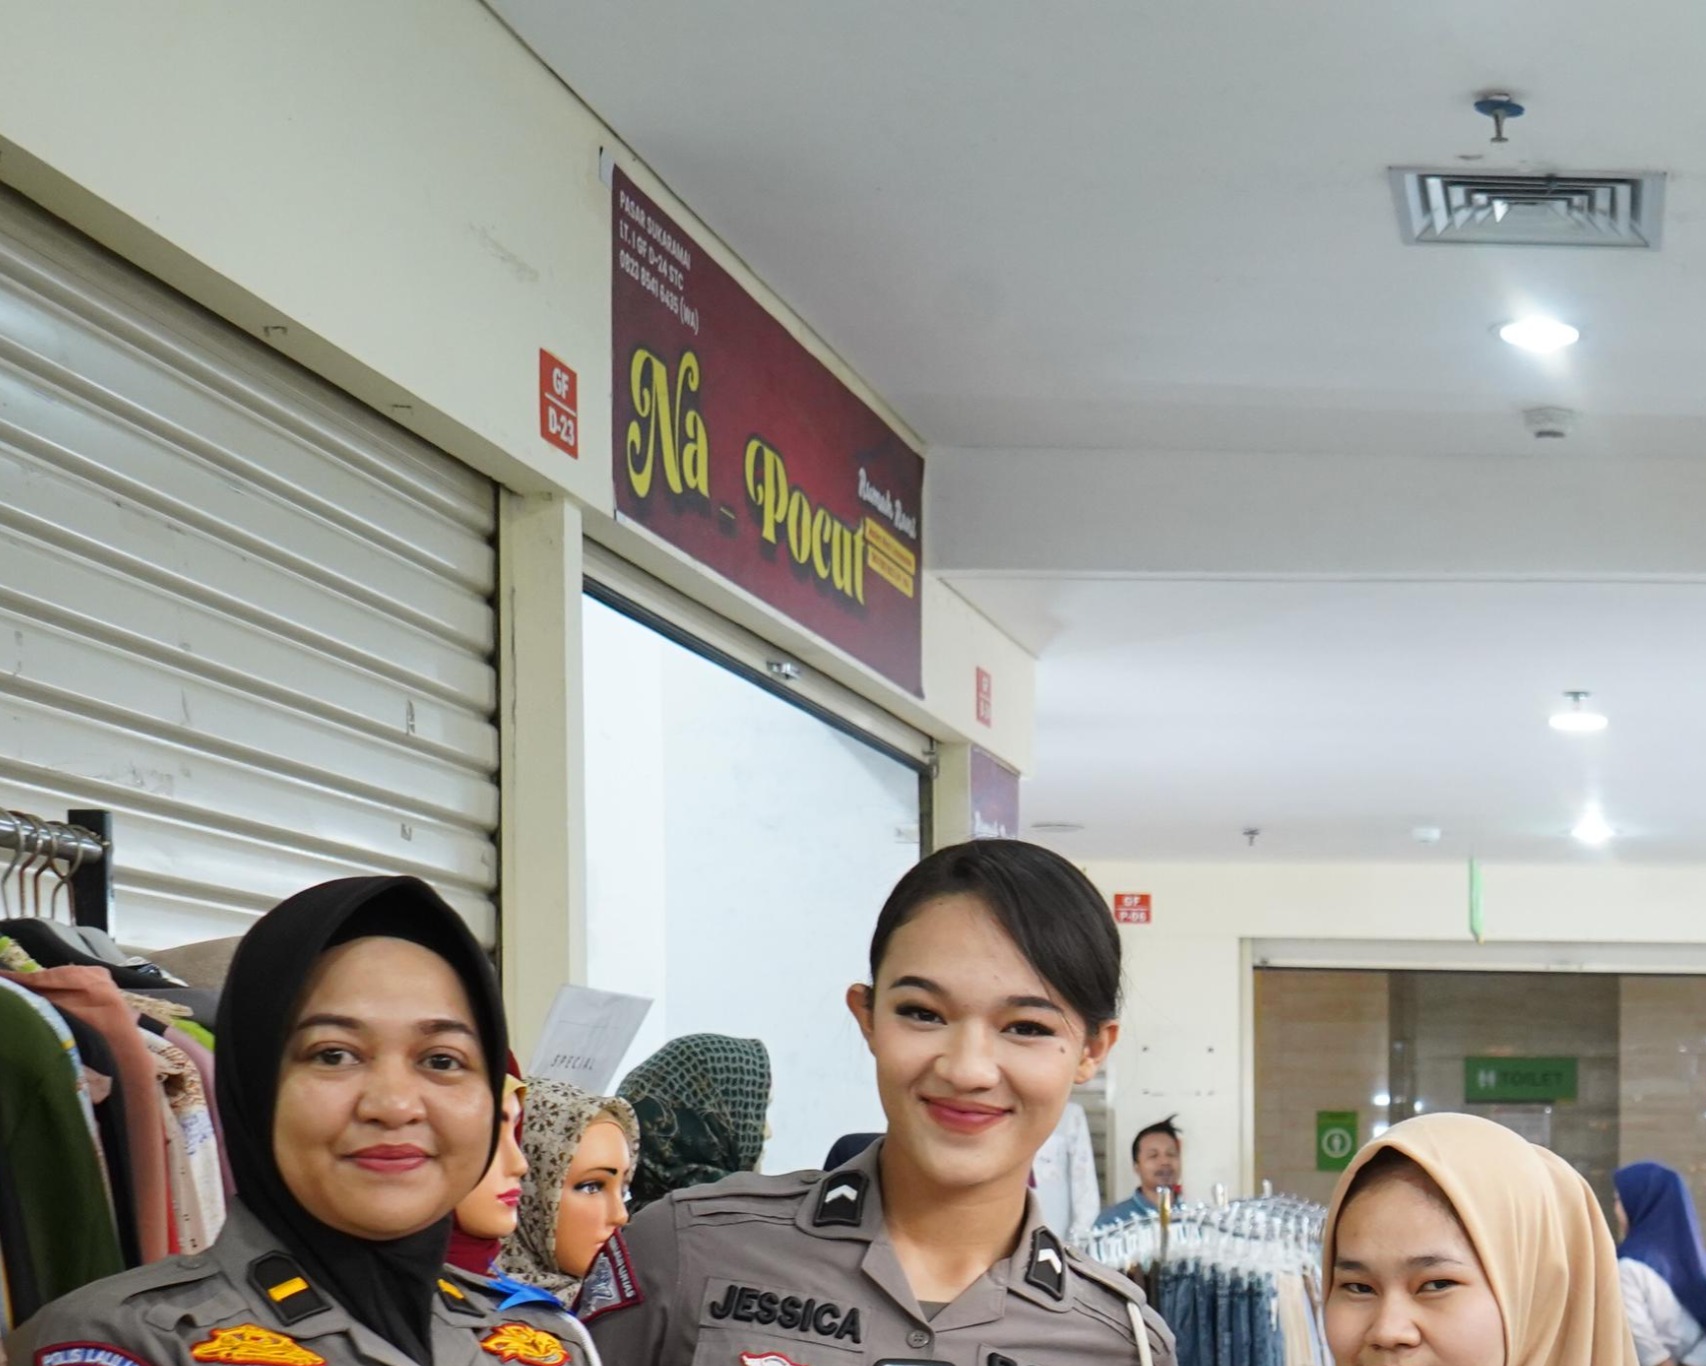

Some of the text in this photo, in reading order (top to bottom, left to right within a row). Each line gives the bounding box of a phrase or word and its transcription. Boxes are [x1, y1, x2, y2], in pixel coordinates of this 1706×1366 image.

[620, 190, 646, 229] PASAR
[552, 367, 570, 399] GF
[548, 405, 575, 447] D-23
[627, 347, 867, 606] Na Pocut
[1502, 1071, 1563, 1085] TOILET
[710, 1285, 863, 1344] JESSICA
